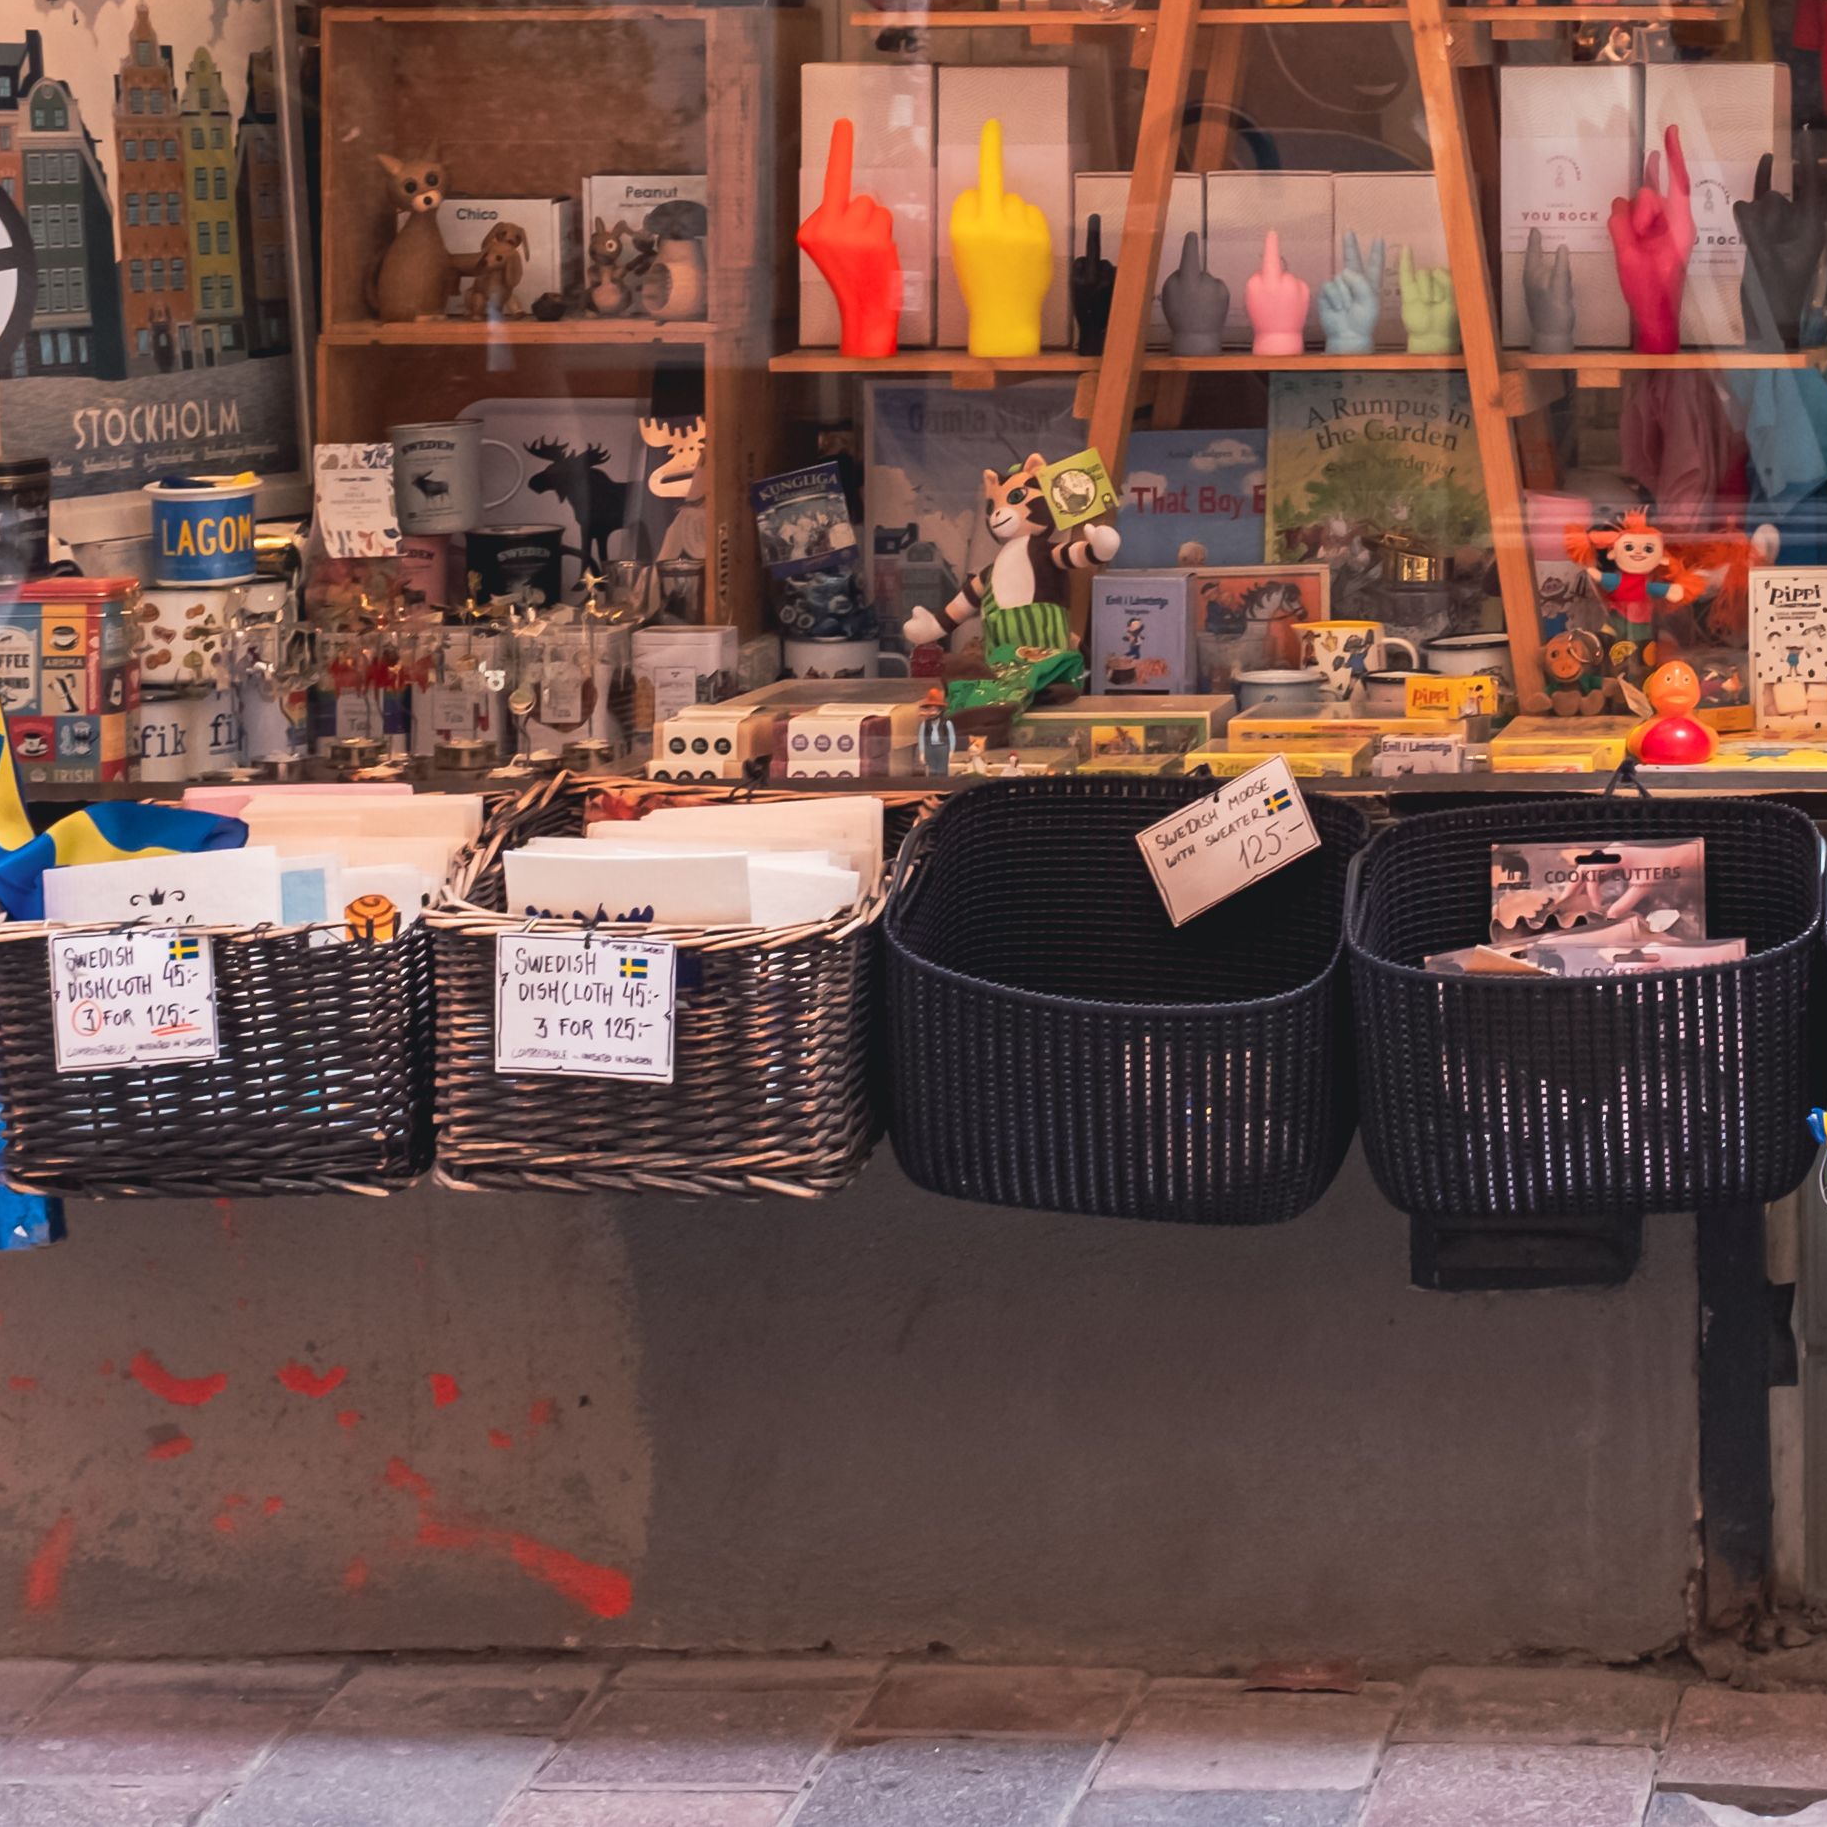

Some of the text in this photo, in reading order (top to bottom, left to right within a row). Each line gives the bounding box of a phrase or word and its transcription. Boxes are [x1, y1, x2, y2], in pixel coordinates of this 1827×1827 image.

[625, 186, 678, 200] Peanut
[456, 207, 499, 222] Chico
[1521, 212, 1600, 222] YOU ROCK
[74, 399, 242, 451] STOCKHOLM
[1307, 396, 1472, 430] A Rumpus in
[1317, 420, 1459, 452] the Garden
[759, 473, 838, 501] KUNGLIGA
[1135, 486, 1191, 513] That
[1198, 484, 1246, 521] Boy
[161, 513, 254, 557] LAGOM
[496, 546, 551, 562] SWEDEN
[53, 769, 95, 784] IRISH
[1155, 778, 1271, 851] SWEDISH MOOSE
[1166, 808, 1266, 869] WITH SWEATER
[1545, 868, 1606, 885] COOKIE
[1611, 865, 1681, 883] CUTTERS
[63, 946, 134, 971] SWEDISH
[514, 947, 597, 975] SWEDISH
[67, 977, 152, 1004] DISHCLOTH
[518, 981, 613, 1007] DISHCLOTH
[82, 1008, 97, 1031] 3
[103, 1010, 133, 1027] FOR
[533, 1016, 549, 1039] 3
[560, 1017, 594, 1036] FOR
